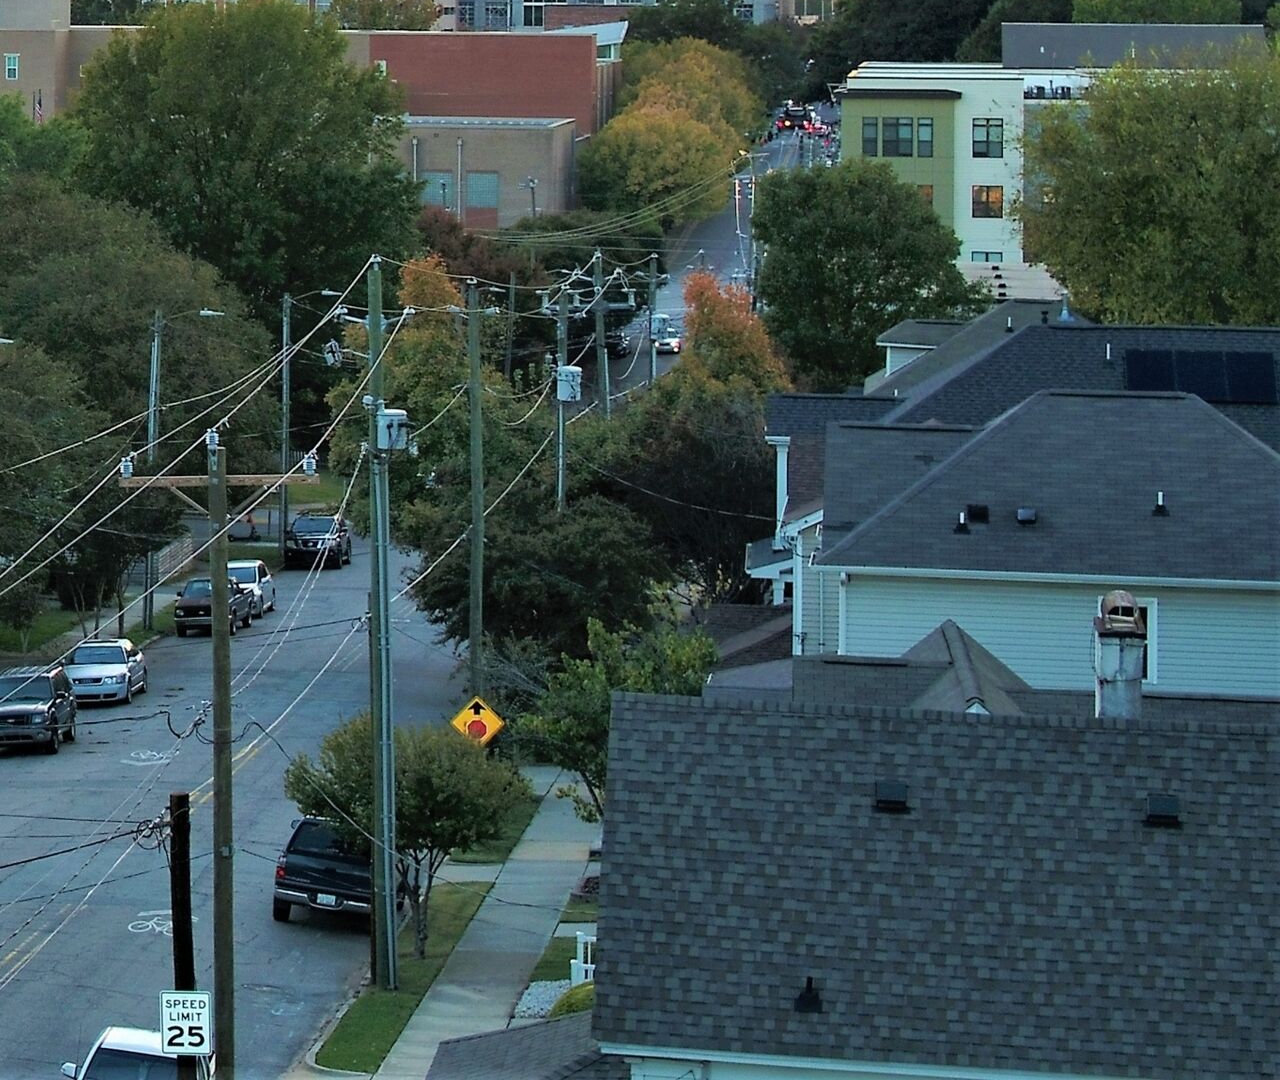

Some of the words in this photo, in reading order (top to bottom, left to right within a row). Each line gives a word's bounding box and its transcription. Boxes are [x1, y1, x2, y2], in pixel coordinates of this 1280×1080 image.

[165, 999, 206, 1009] SPEED
[169, 1012, 203, 1022] LIMIT
[167, 1025, 205, 1047] 25
